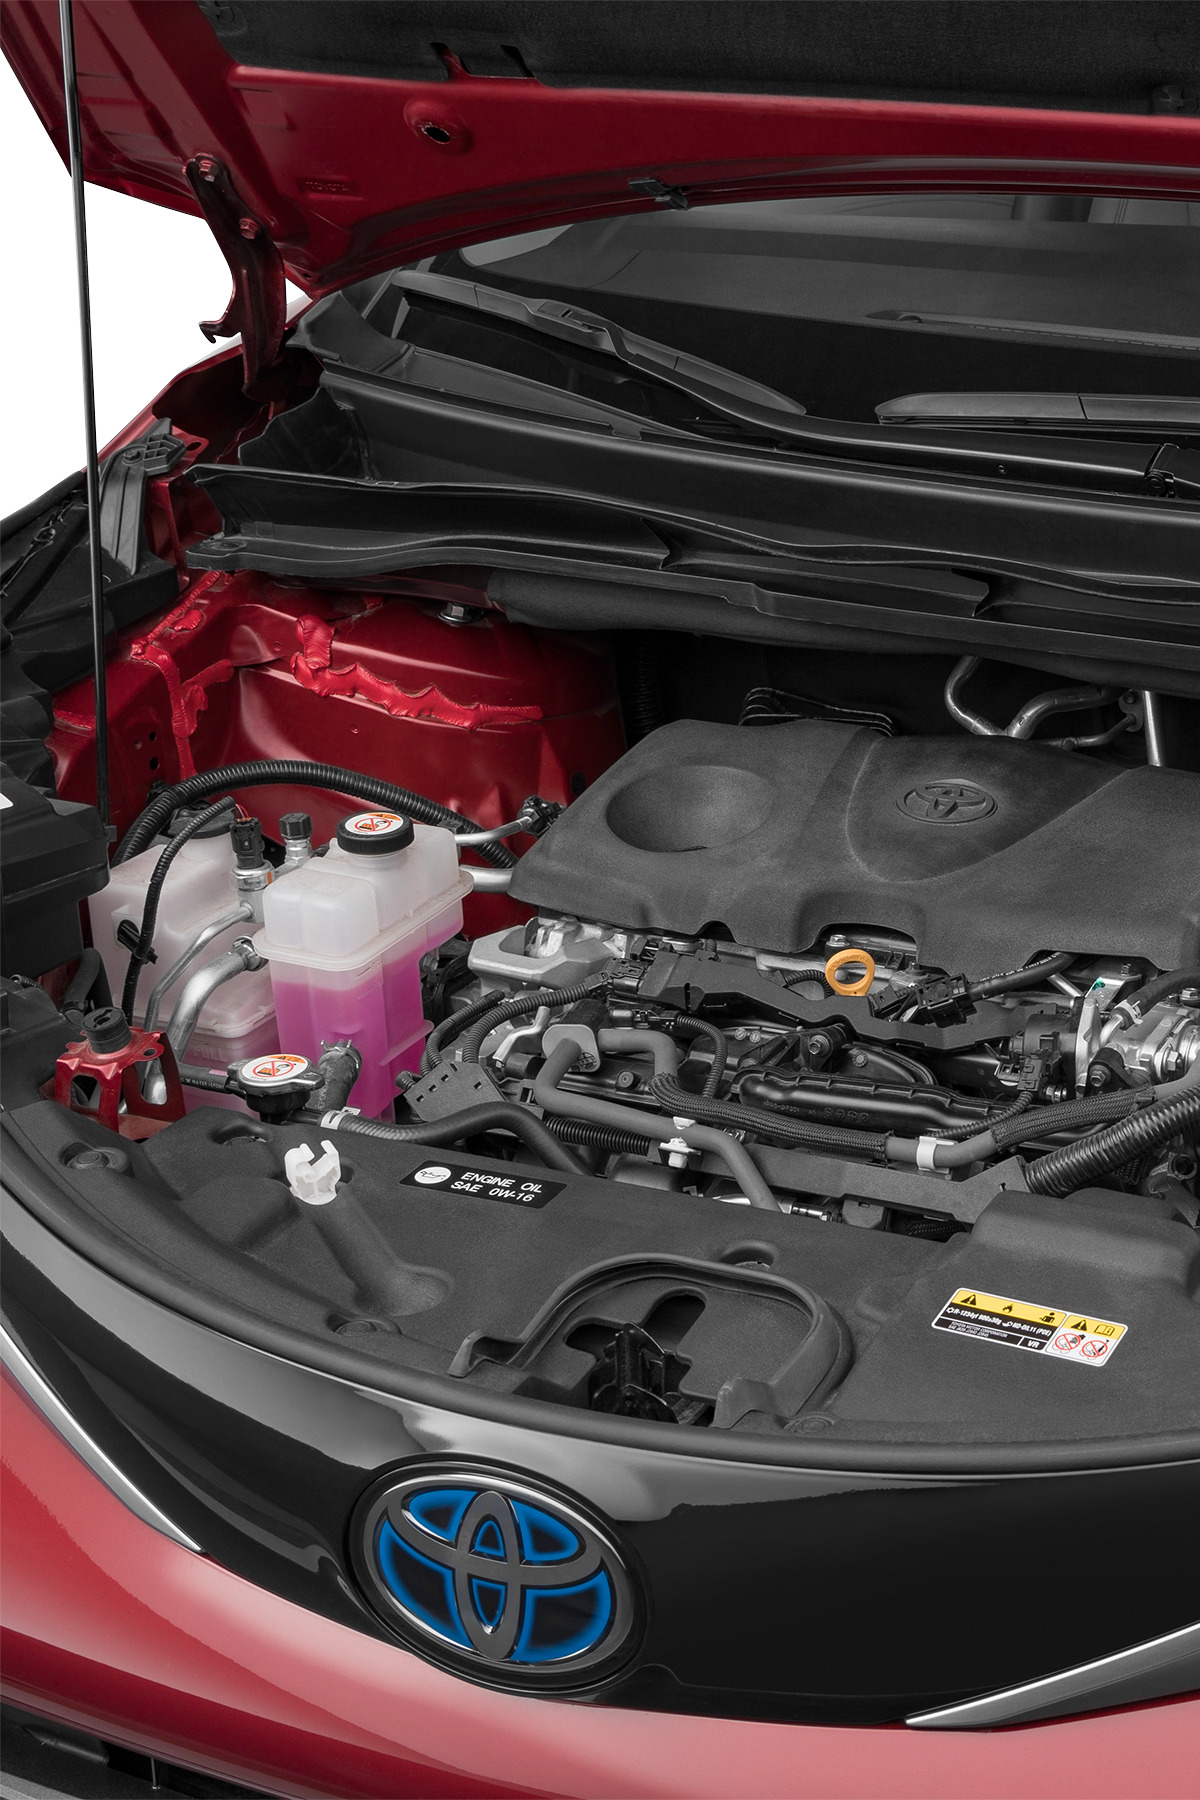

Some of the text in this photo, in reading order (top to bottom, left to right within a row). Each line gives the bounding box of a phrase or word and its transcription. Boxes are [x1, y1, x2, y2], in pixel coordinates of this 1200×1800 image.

[450, 1181, 535, 1202] SAE 0W-16
[460, 1171, 543, 1193] ENGINE OIL
[1027, 1340, 1039, 1348] VR
